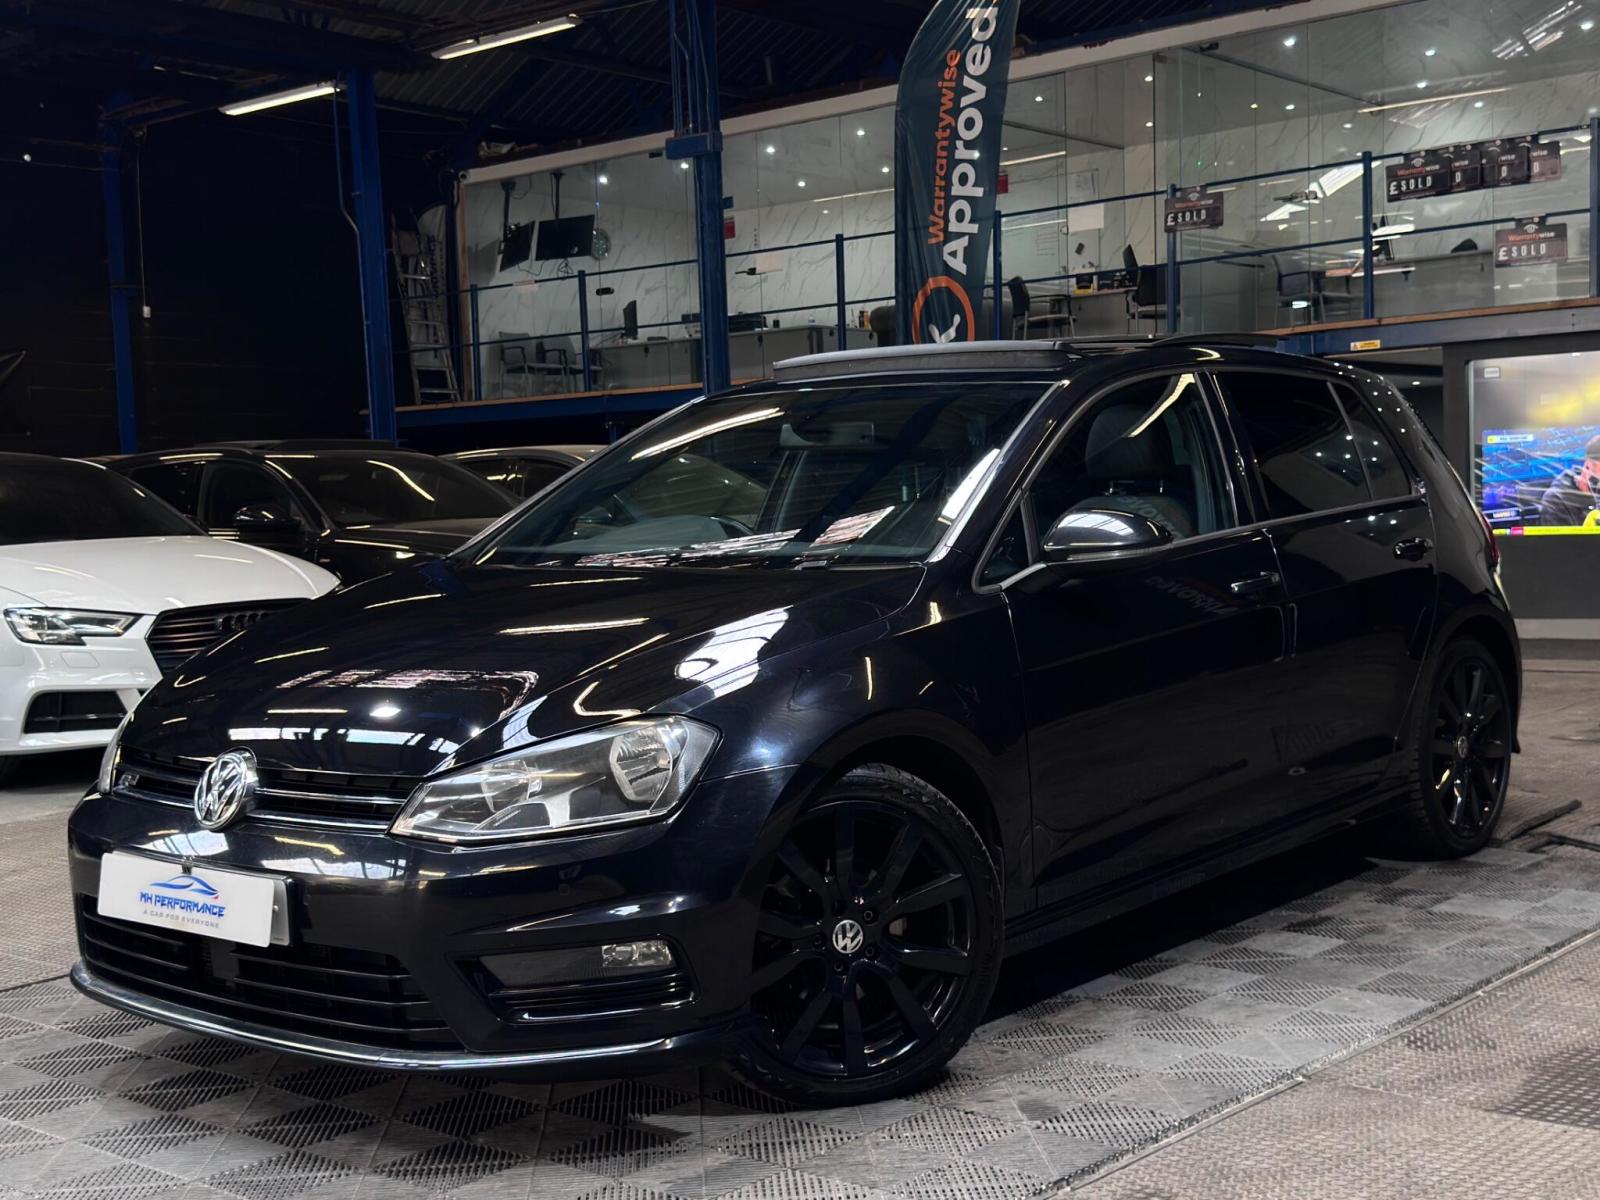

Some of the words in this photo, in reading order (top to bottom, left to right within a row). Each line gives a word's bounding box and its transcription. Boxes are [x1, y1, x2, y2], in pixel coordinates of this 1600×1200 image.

[928, 49, 961, 245] Warrantywise
[943, 6, 999, 276] Approved
[139, 891, 154, 905] MH
[154, 894, 226, 918] PERFORMANCE
[181, 917, 220, 929] EVERYONE
